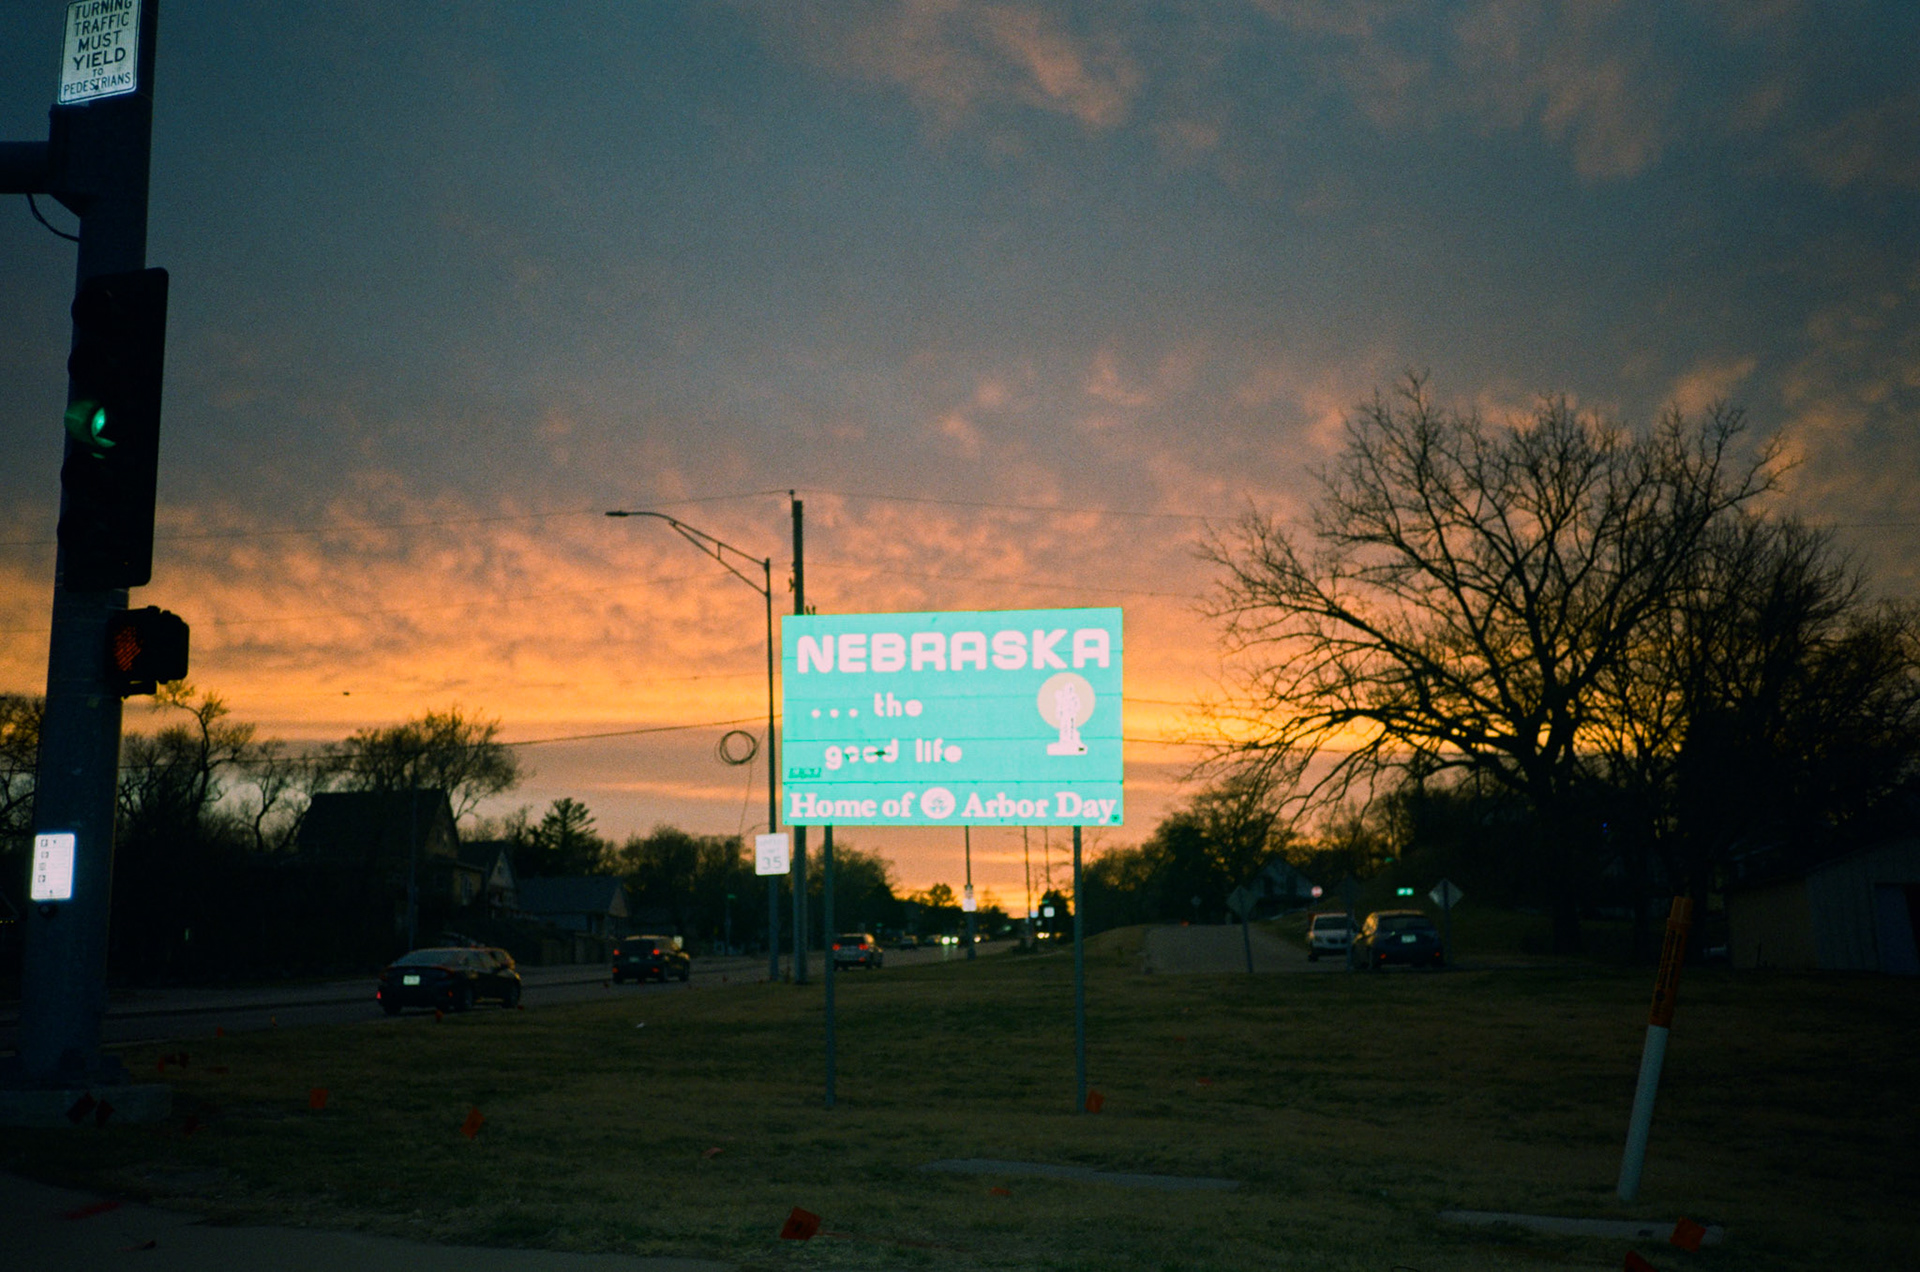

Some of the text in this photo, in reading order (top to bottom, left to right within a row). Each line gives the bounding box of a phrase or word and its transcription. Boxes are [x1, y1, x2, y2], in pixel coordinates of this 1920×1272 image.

[75, 0, 132, 19] TURNING
[74, 12, 130, 37] TRAFFIC
[77, 30, 122, 53] MUST
[73, 47, 126, 71] YIELD
[63, 72, 131, 96] PEDESTRIANS
[92, 68, 104, 77] TO
[797, 628, 1110, 674] NEBRASKA
[873, 692, 923, 717] the
[824, 738, 962, 770] good life
[789, 791, 1117, 824] Home of Arbor Day
[762, 856, 782, 870] 35
